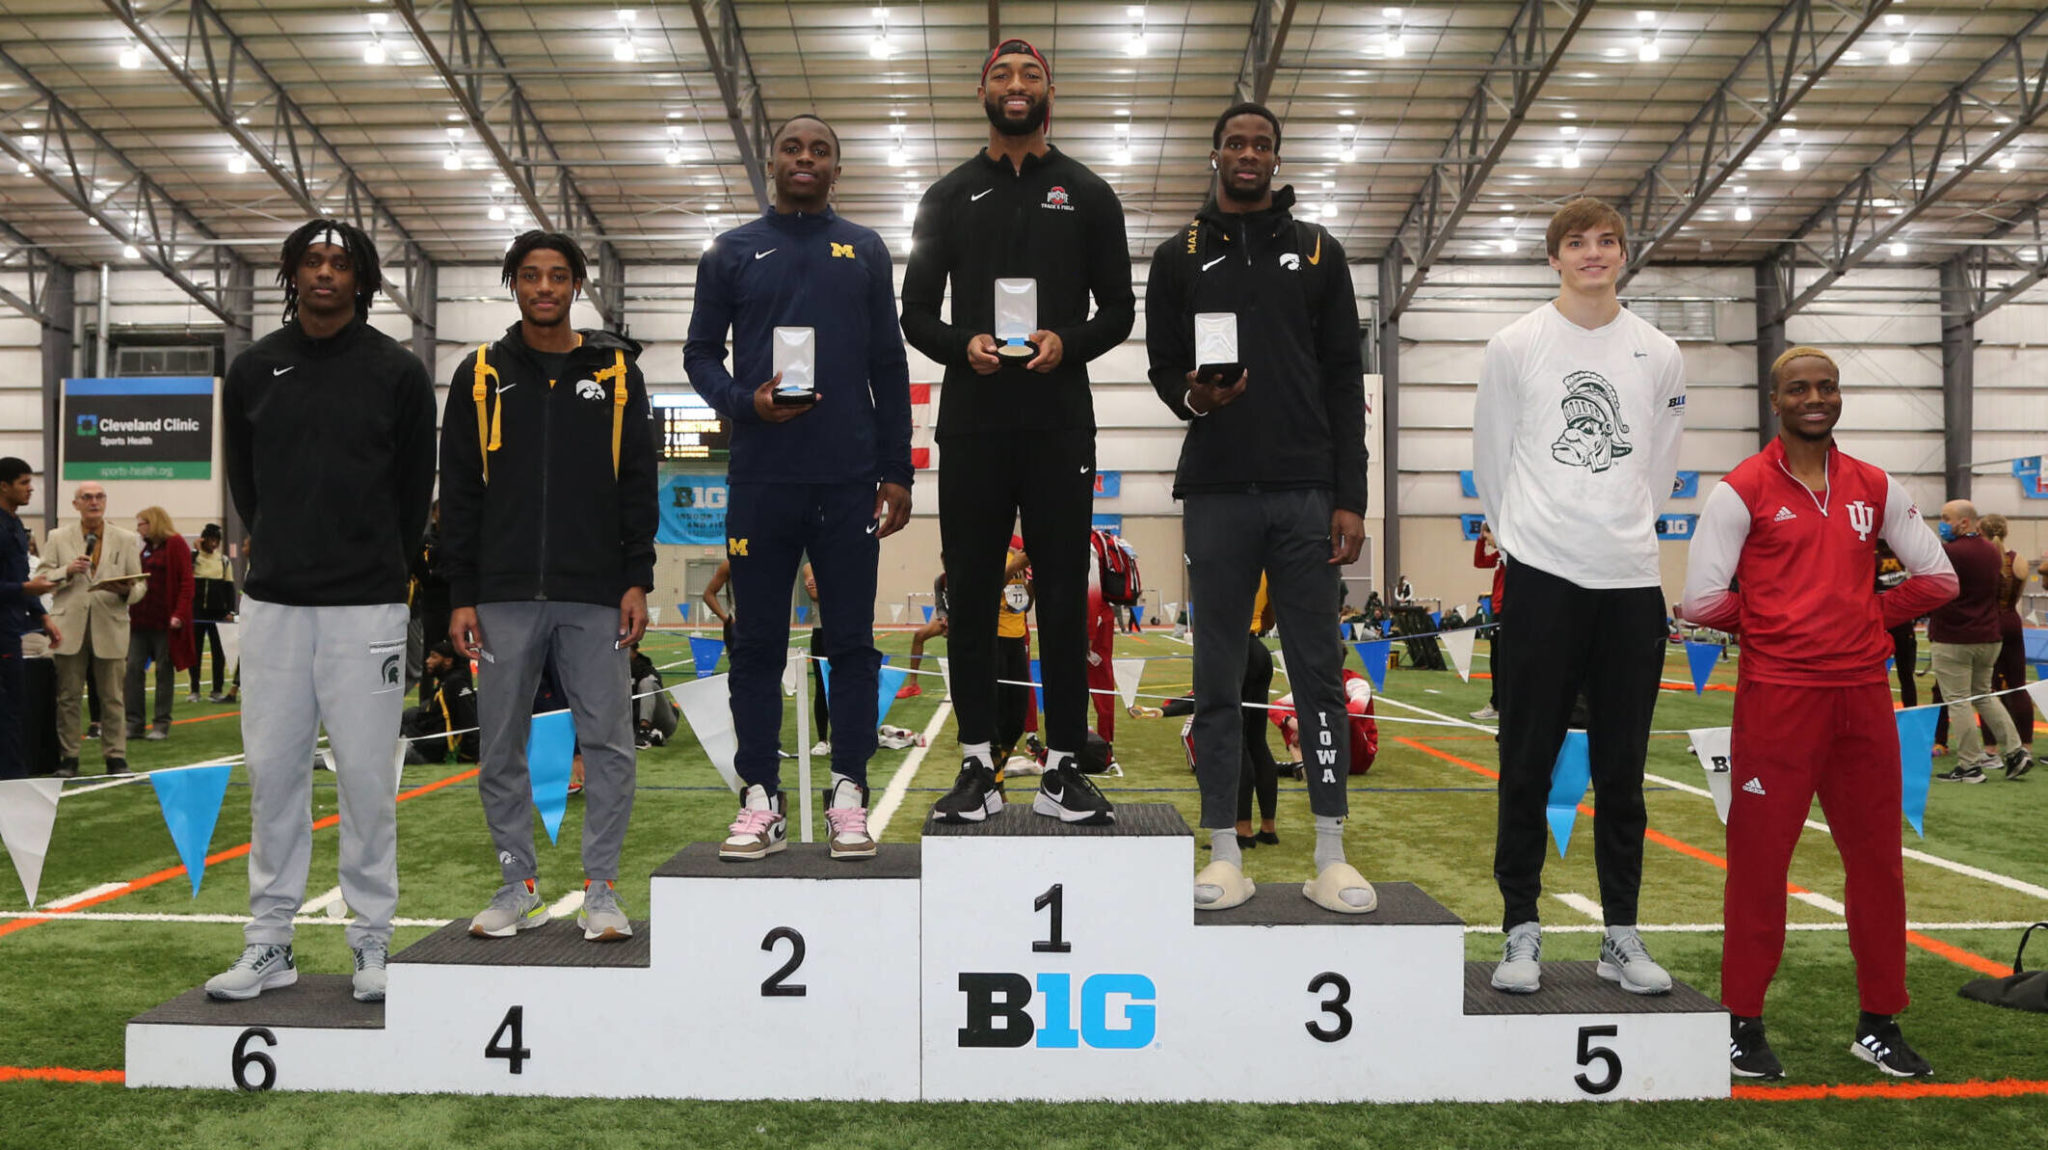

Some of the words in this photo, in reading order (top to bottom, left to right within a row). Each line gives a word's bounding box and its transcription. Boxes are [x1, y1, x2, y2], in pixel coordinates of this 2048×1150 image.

[831, 242, 856, 259] M
[1187, 229, 1198, 254] MAX
[100, 418, 161, 432] Cleveland
[163, 418, 200, 432] Clinic
[100, 436, 126, 447] Sports
[127, 436, 153, 446] Health
[101, 466, 174, 477] sports-health.org
[728, 537, 749, 556] M
[1316, 711, 1337, 784] IOWA
[1032, 883, 1072, 953] 1
[760, 926, 807, 997] 2
[484, 1005, 531, 1075] 4
[1305, 971, 1353, 1043] 3
[232, 1026, 278, 1092] 6
[1574, 1024, 1623, 1096] 5
